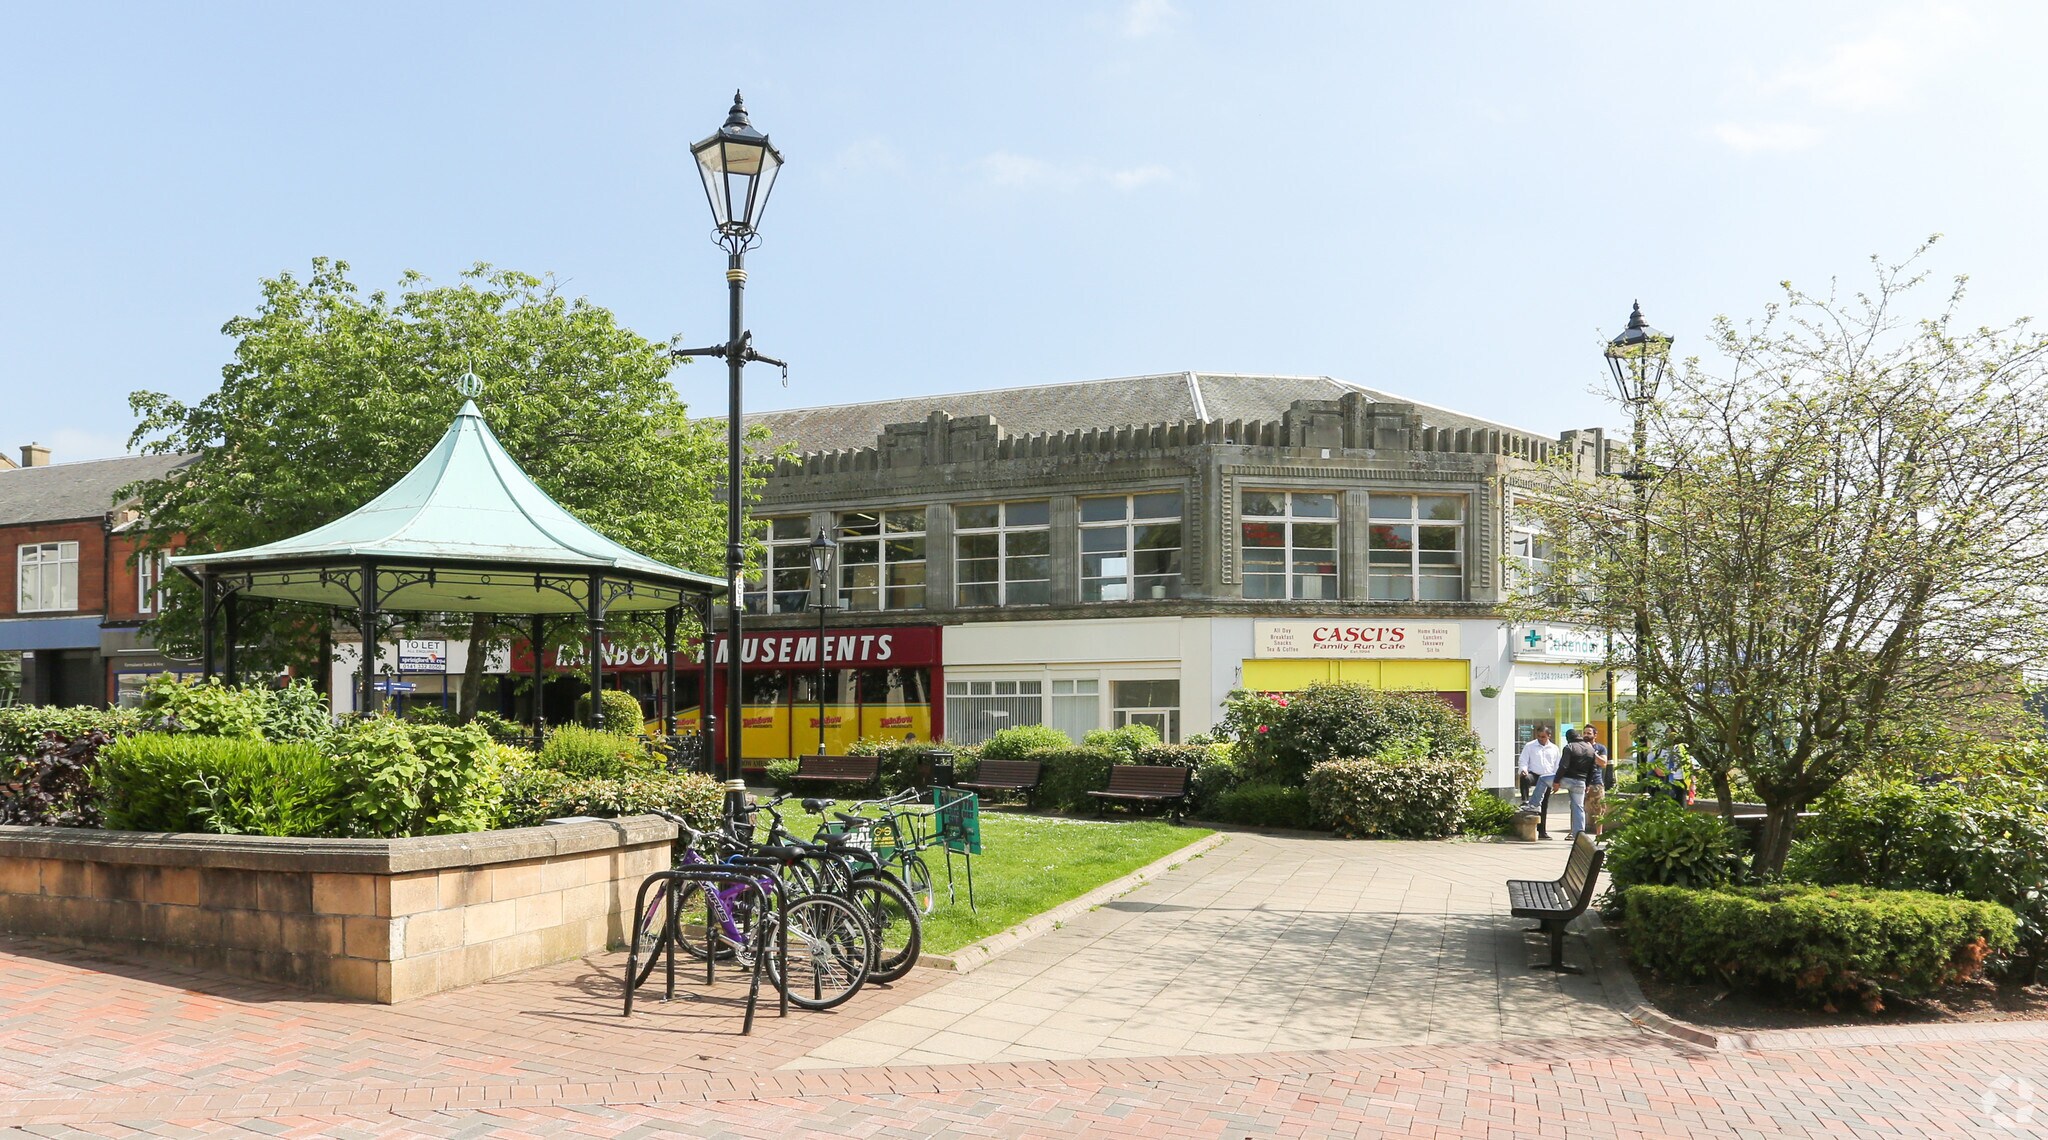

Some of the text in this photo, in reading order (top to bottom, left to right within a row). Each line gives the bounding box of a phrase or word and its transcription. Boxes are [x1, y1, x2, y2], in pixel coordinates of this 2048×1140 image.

[1312, 627, 1405, 642] CASCI'S
[405, 641, 440, 649] TO LET
[1313, 643, 1349, 651] Family
[846, 832, 872, 842] EAL
